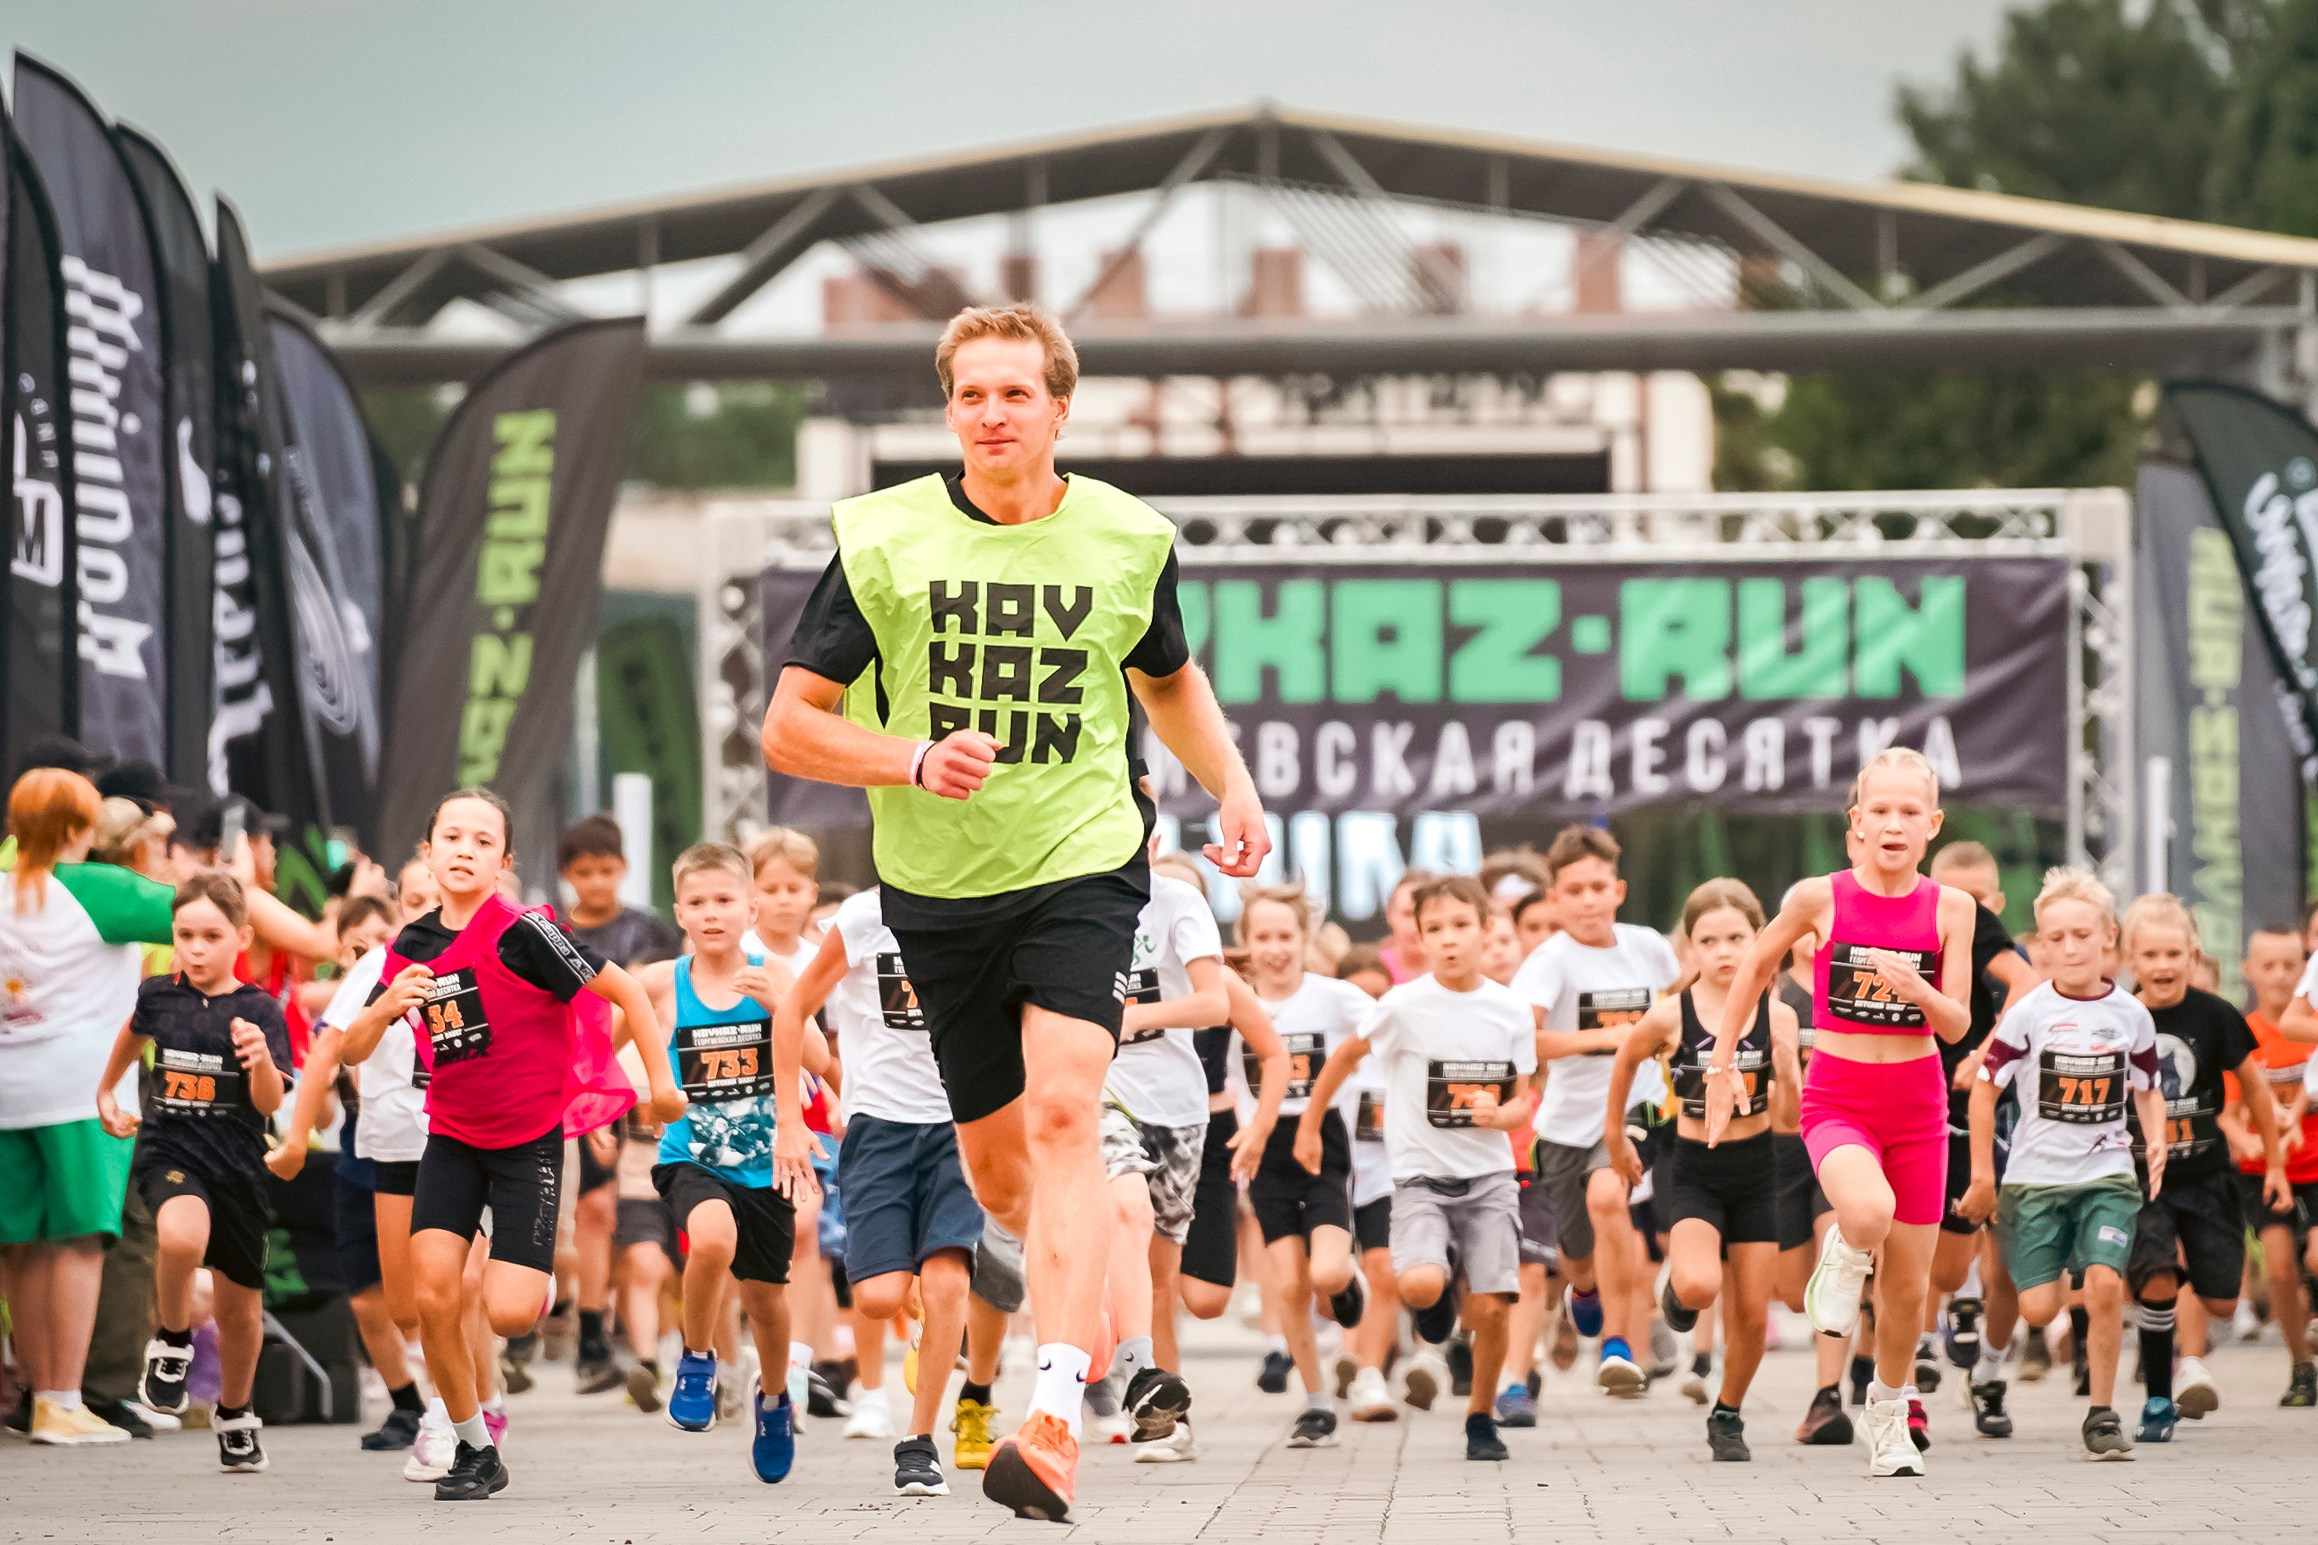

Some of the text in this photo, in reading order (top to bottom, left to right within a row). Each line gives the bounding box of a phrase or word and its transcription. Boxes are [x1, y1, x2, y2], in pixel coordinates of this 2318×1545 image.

[929, 580, 1093, 642] KAV
[929, 640, 1089, 704] KAZ
[1853, 970, 1911, 1004] 72
[701, 1047, 758, 1080] 733
[164, 1071, 216, 1102] 736
[2059, 1077, 2111, 1104] 717
